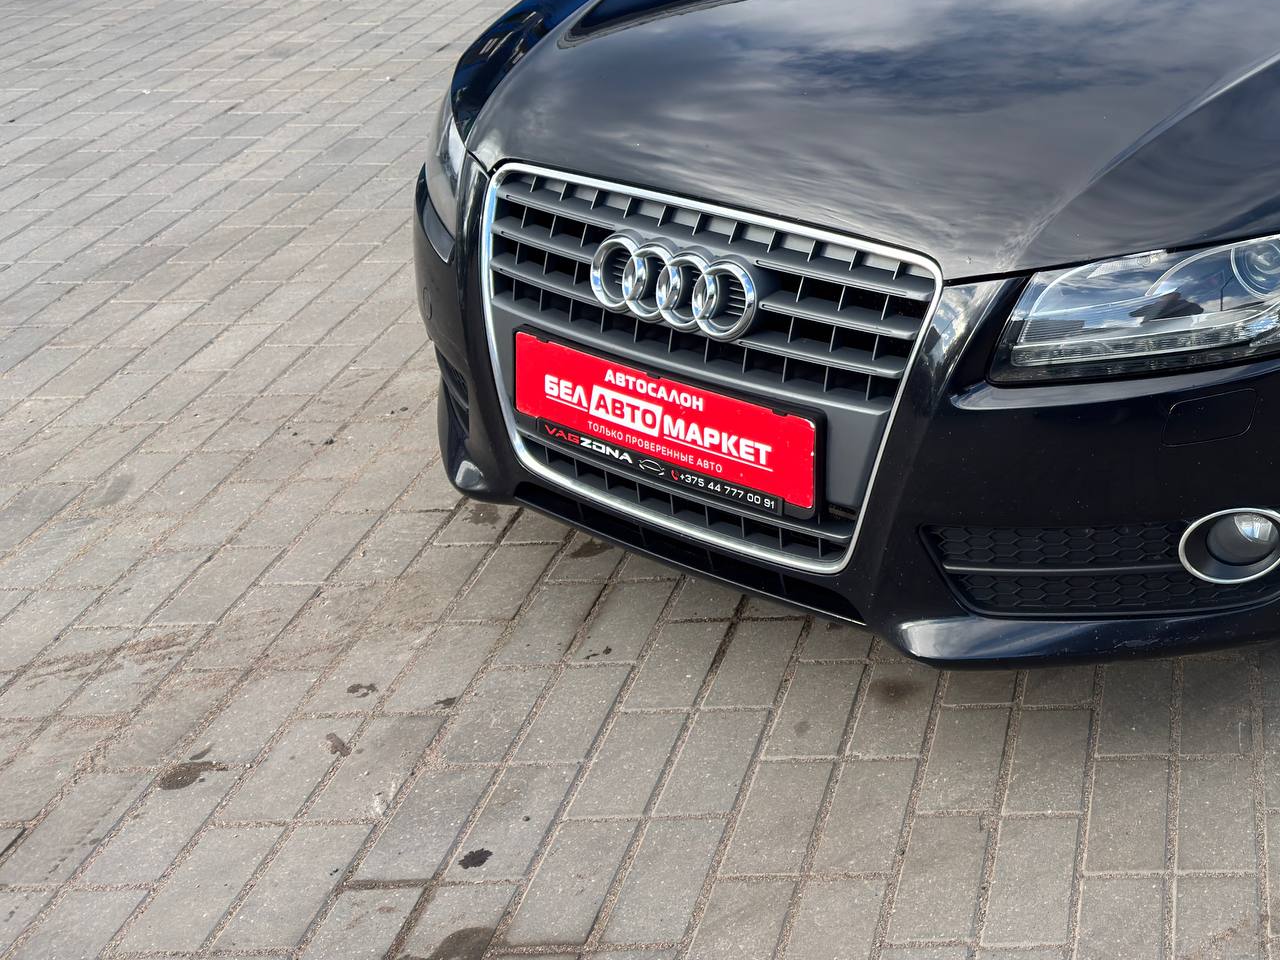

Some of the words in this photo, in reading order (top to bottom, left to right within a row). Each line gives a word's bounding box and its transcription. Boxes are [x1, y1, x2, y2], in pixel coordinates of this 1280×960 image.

[603, 368, 704, 412] АВТОСАЛОН
[544, 374, 588, 409] БЕЛ
[594, 391, 658, 430] АВТО
[663, 414, 774, 466] МАРКЕТ
[587, 420, 625, 441] ТОЛЬКО
[625, 434, 695, 465] ПРОВЕРЕННЫЕ
[696, 458, 723, 473] АВТО
[679, 473, 705, 488] +375
[707, 481, 721, 492] 44
[724, 485, 744, 498] 777
[746, 493, 761, 505] 00
[763, 498, 775, 510] 91
